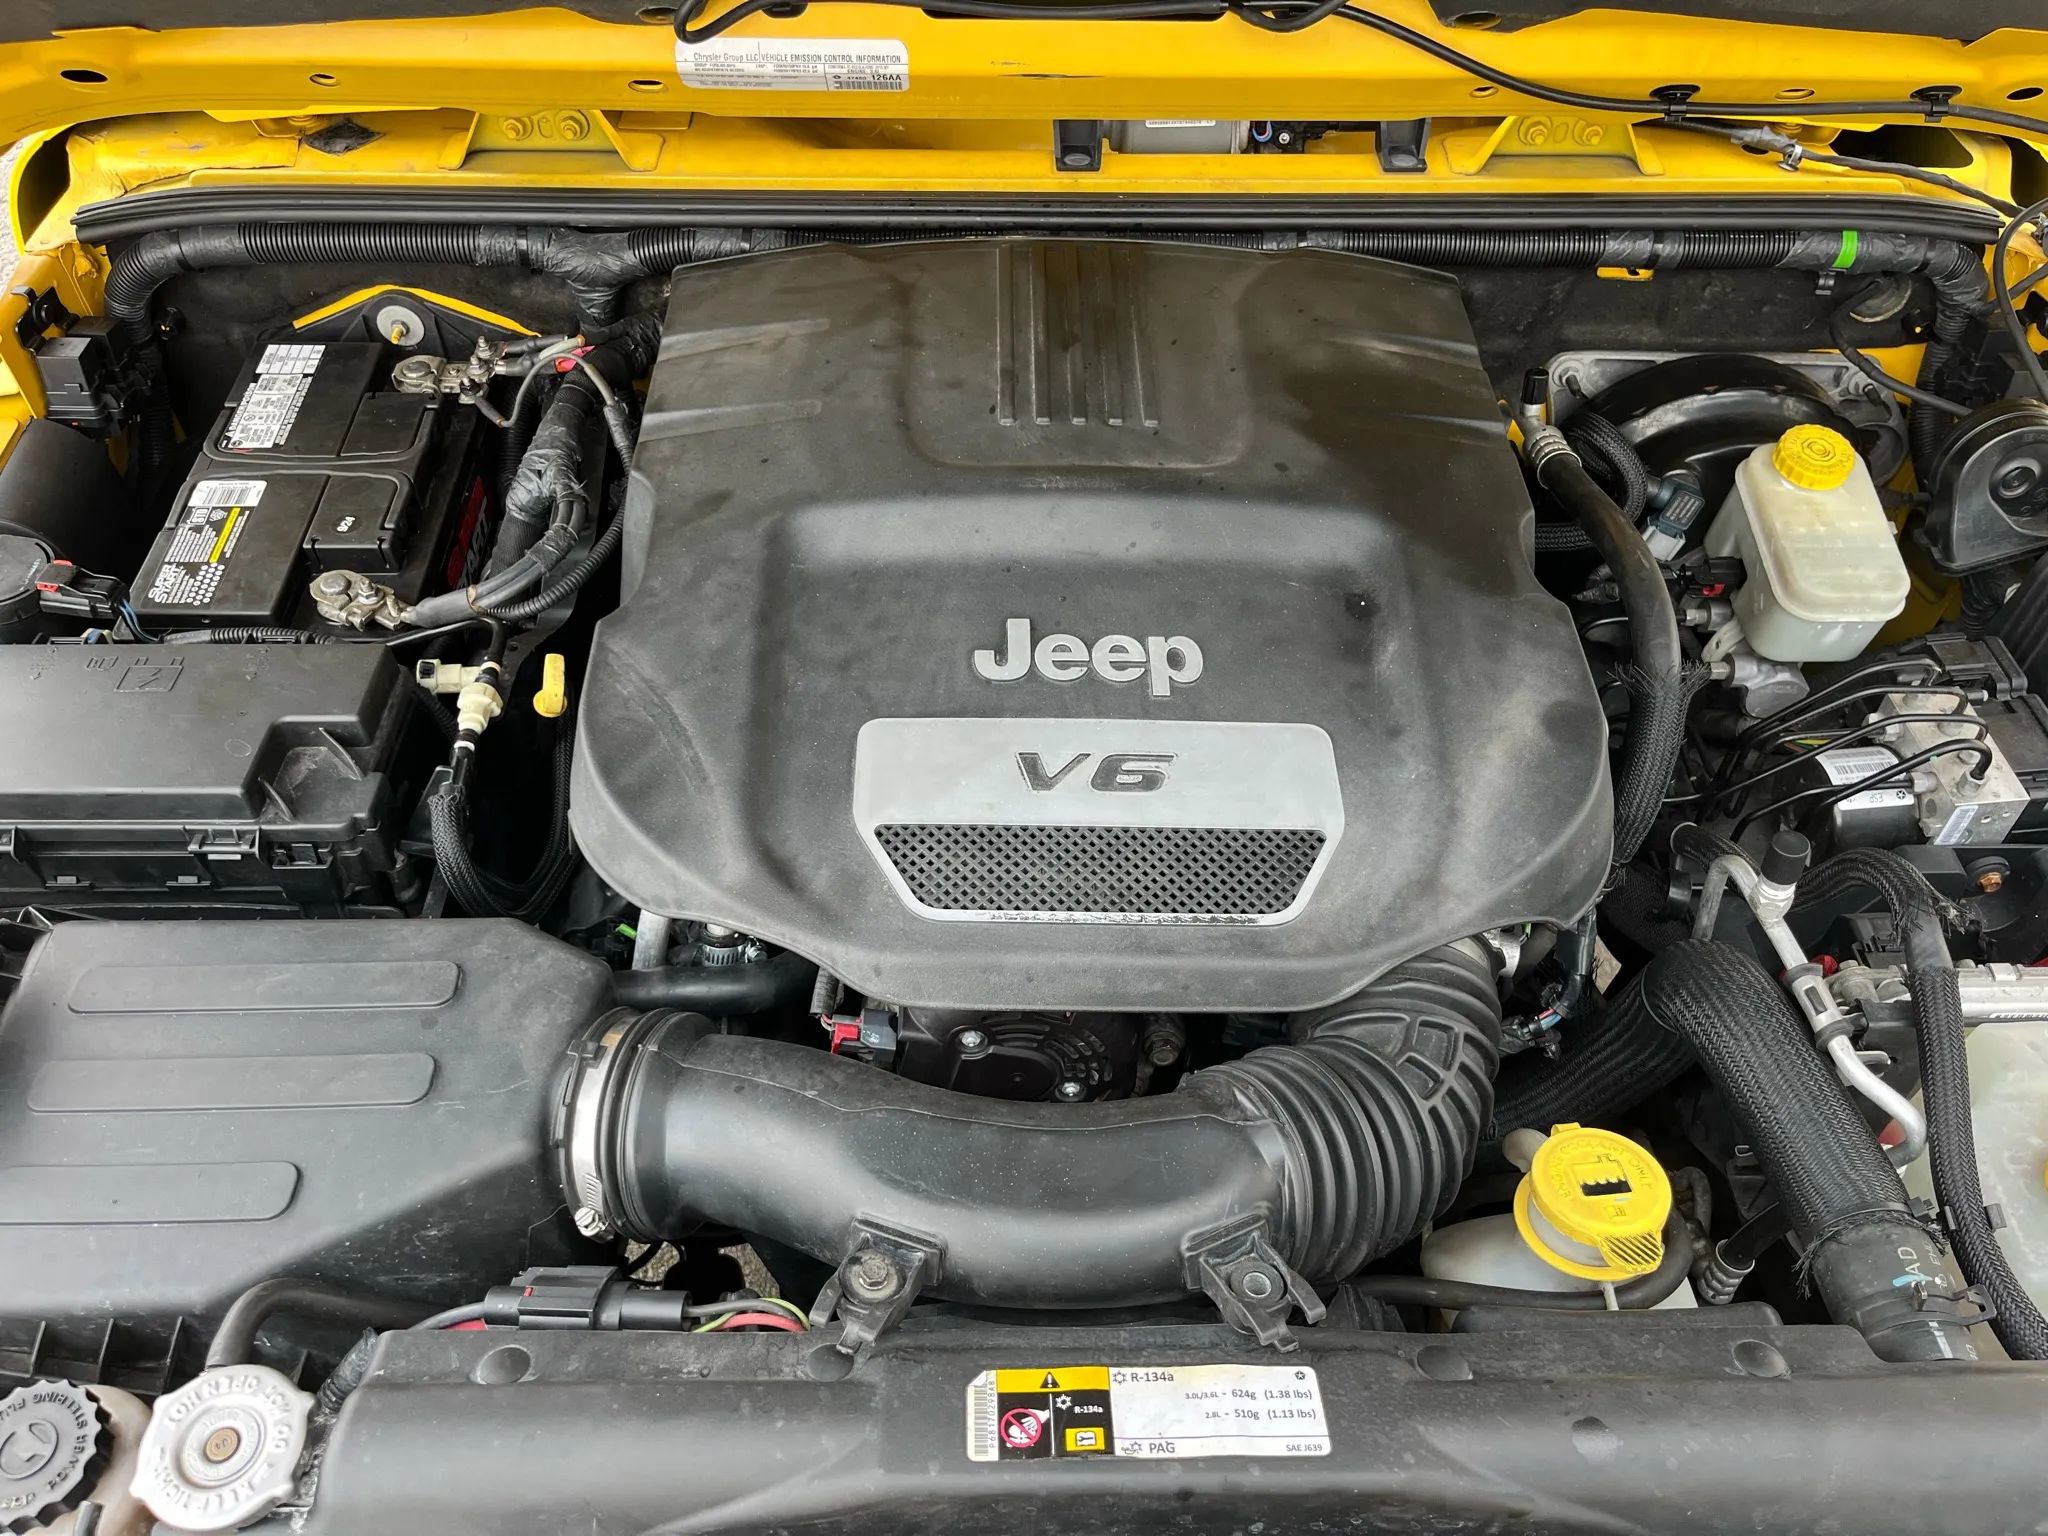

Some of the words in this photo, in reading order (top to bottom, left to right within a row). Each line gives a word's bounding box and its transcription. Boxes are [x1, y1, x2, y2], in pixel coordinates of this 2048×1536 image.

[693, 52, 721, 63] Chrysler
[723, 52, 744, 63] Group
[746, 53, 759, 61] LLC
[761, 53, 788, 62] VEHICLE
[790, 54, 822, 63] EMISSION
[824, 54, 854, 63] CONTROL
[856, 55, 901, 63] INFORMATION
[148, 564, 173, 598] SUPER
[154, 563, 181, 604] START
[973, 618, 1204, 697] Jeep
[1016, 752, 1177, 792] V6
[206, 1374, 261, 1397] OPEN
[1131, 1371, 1175, 1383] R-134a
[1185, 1390, 1219, 1400] 3.0L/3.6L
[1231, 1389, 1257, 1401] 624g
[1264, 1388, 1290, 1400] (1.38
[1293, 1388, 1313, 1400] lbs)
[32, 1391, 89, 1430] STEERING
[167, 1390, 203, 1424] HOT
[1073, 1405, 1104, 1414] R-134a
[1234, 1409, 1260, 1421] 510g
[1267, 1409, 1294, 1421] (1.13
[1297, 1409, 1317, 1421] lbs)
[1149, 1442, 1176, 1454] PAG
[1286, 1443, 1302, 1452] SAE
[1304, 1443, 1323, 1452] J639
[47, 1434, 88, 1491] POWER
